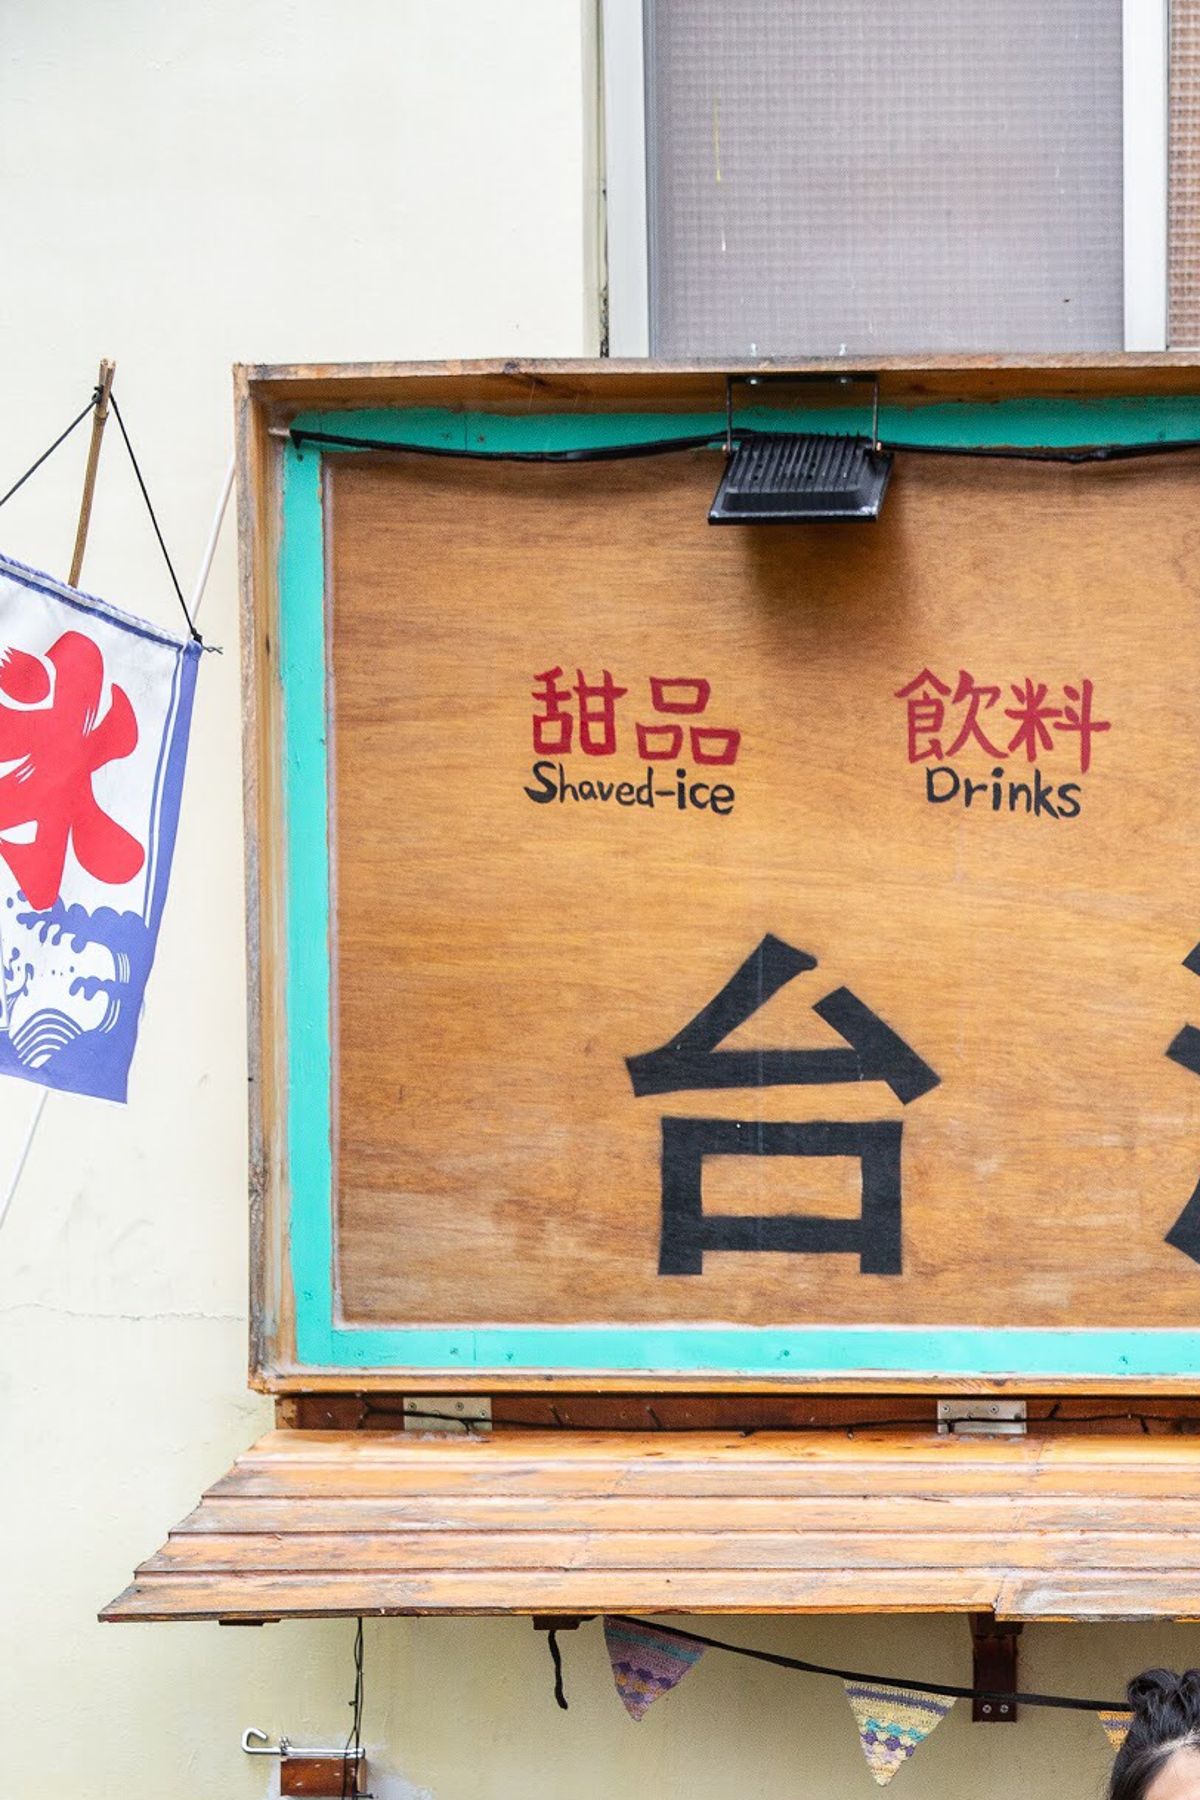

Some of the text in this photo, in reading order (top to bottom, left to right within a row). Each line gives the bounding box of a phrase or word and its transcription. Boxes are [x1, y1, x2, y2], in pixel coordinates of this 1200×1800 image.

[531, 666, 741, 766] 甜品
[894, 667, 1111, 773] 飲料
[524, 761, 735, 816] Shaved-ice
[926, 766, 1081, 819] Drinks
